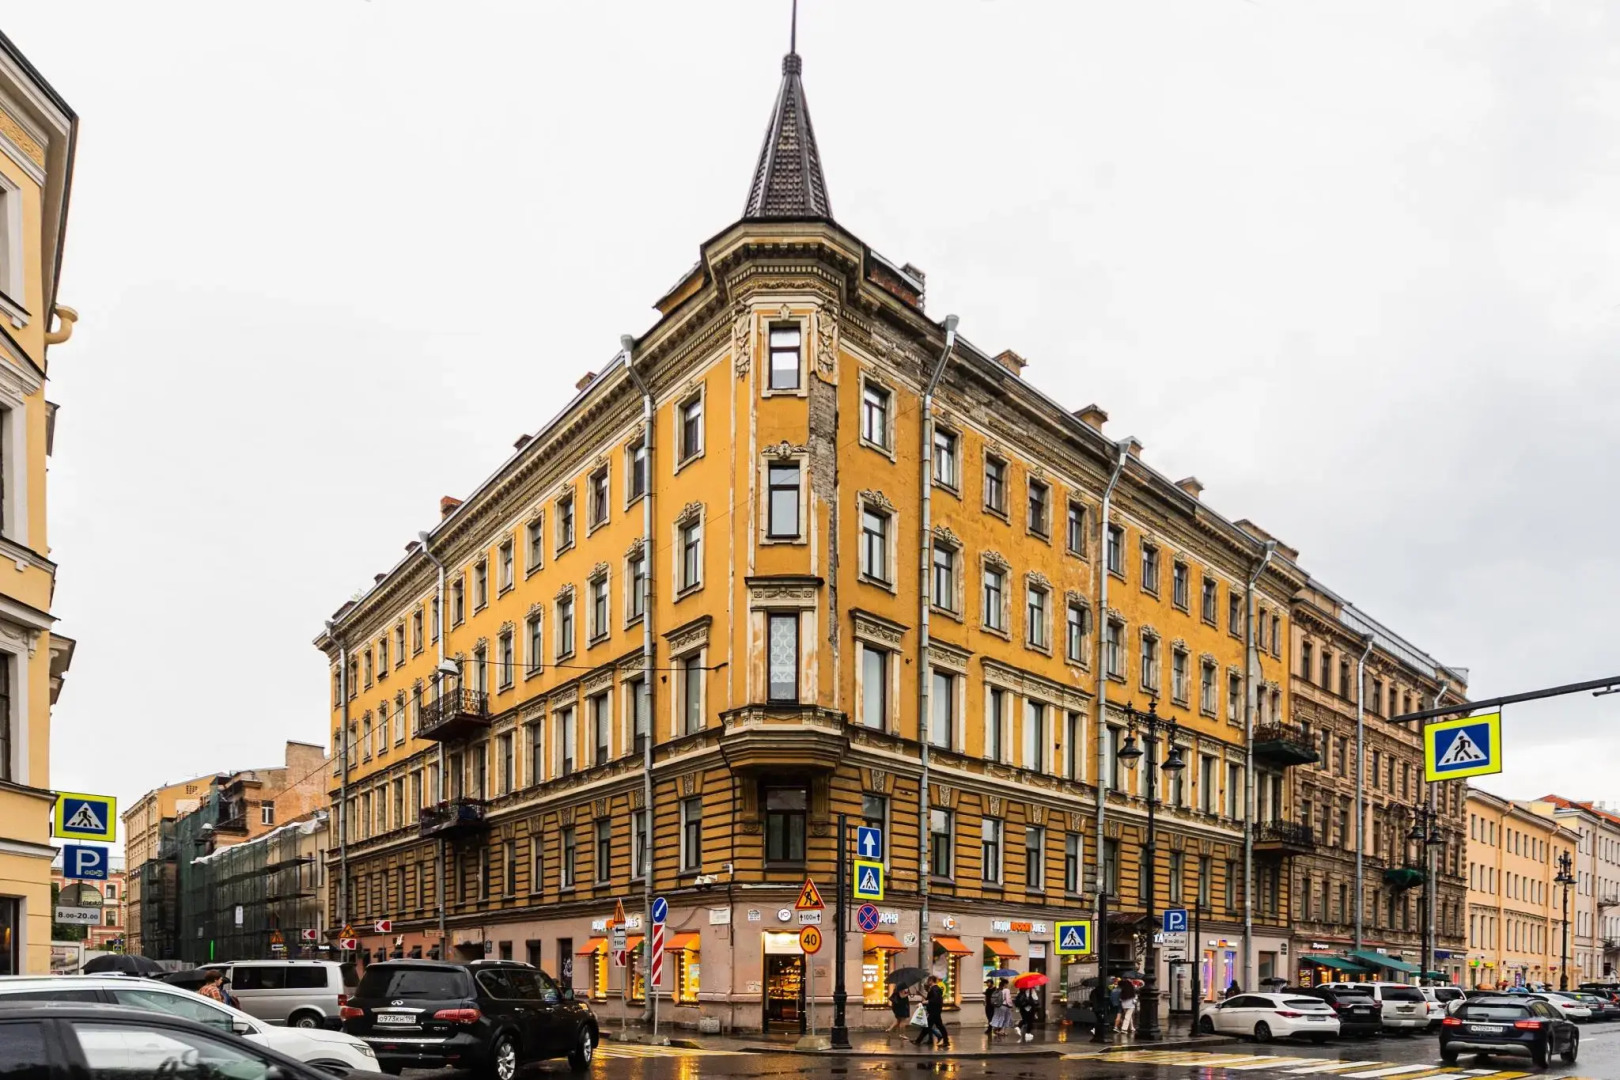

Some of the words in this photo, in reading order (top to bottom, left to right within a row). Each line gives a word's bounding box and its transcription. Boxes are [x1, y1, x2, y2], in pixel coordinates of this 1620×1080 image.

[76, 848, 101, 876] P
[57, 911, 99, 920] 8.00-20.00
[1169, 912, 1183, 930] P
[803, 933, 817, 946] 40
